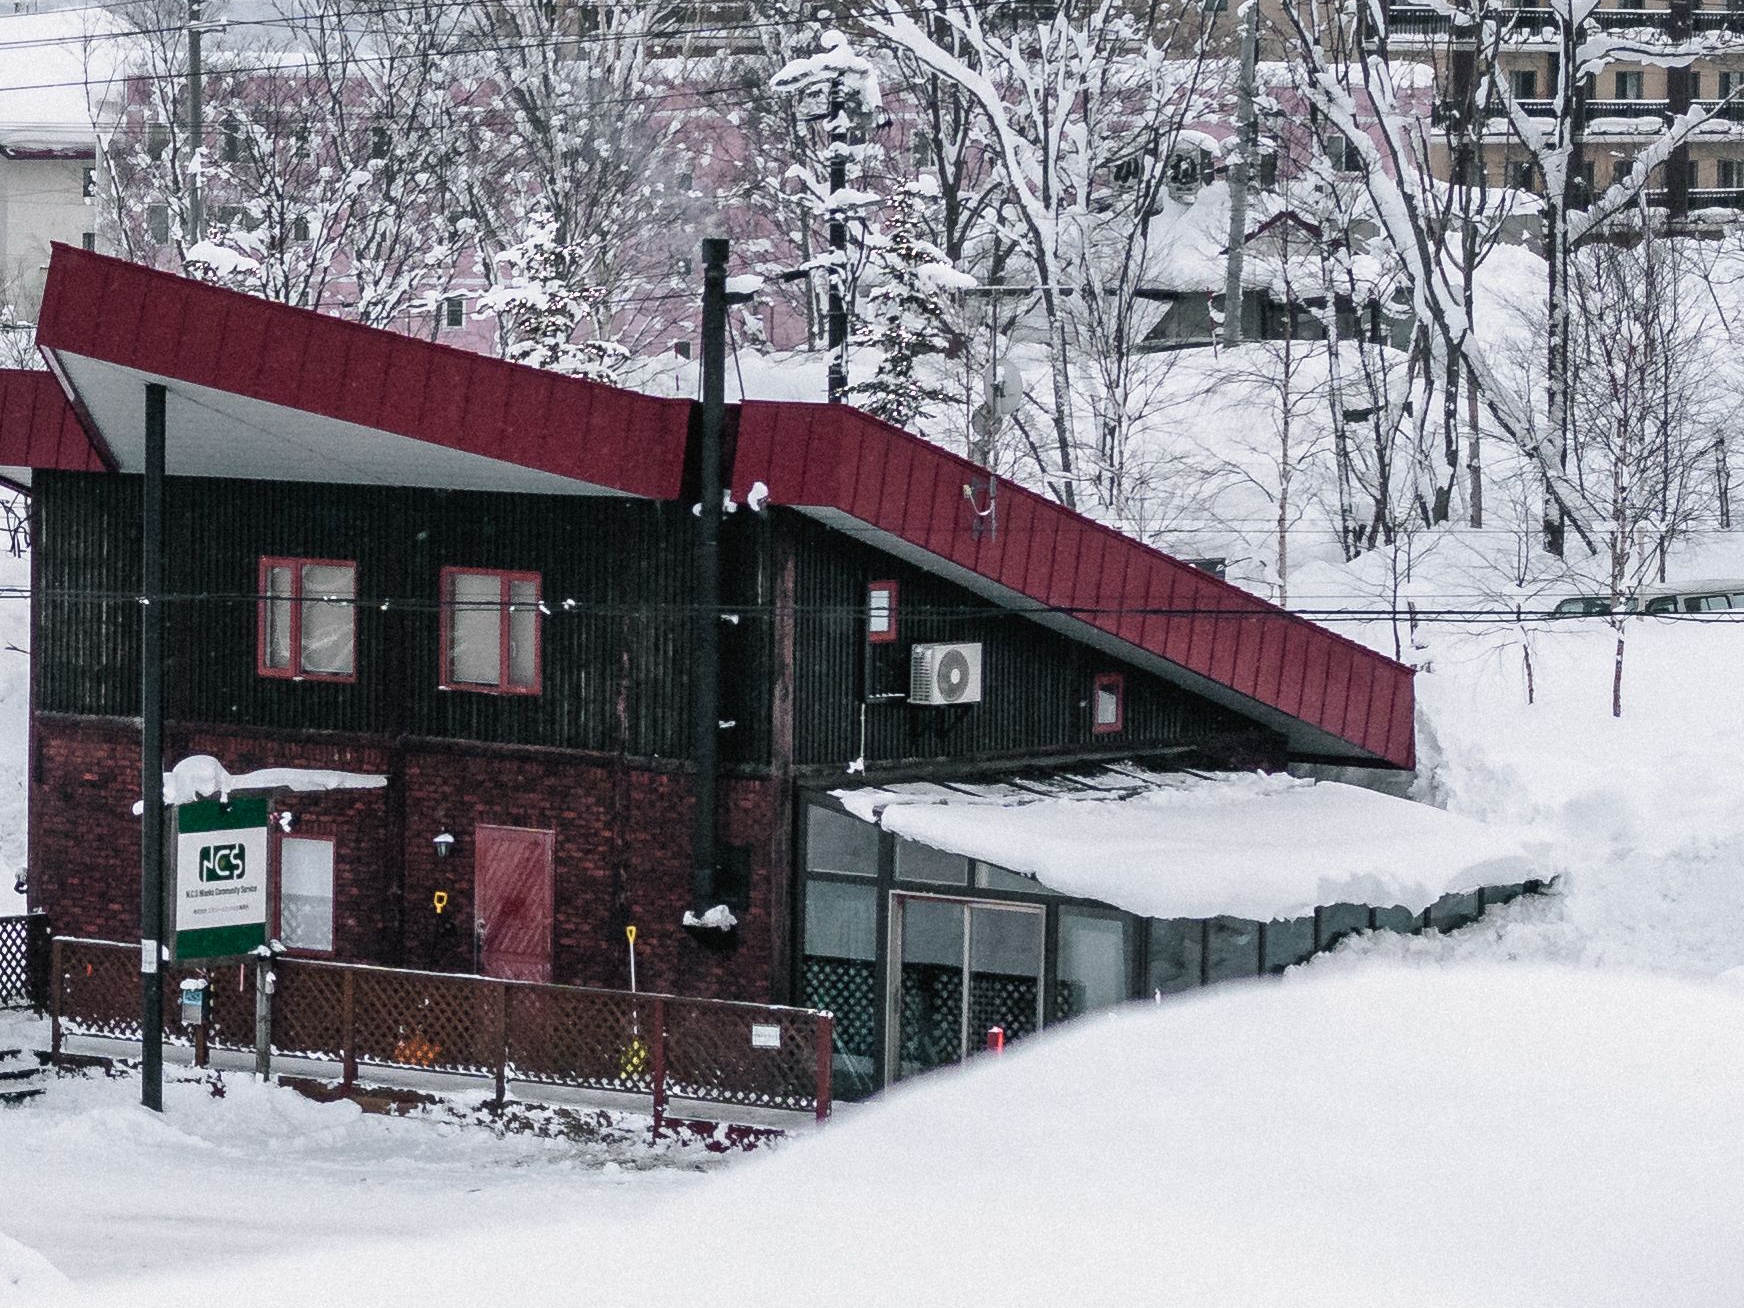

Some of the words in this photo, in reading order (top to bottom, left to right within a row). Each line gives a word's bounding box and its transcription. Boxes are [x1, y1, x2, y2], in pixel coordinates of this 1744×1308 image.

[202, 843, 243, 882] NCS
[215, 886, 240, 895] Community
[241, 885, 257, 893] Service
